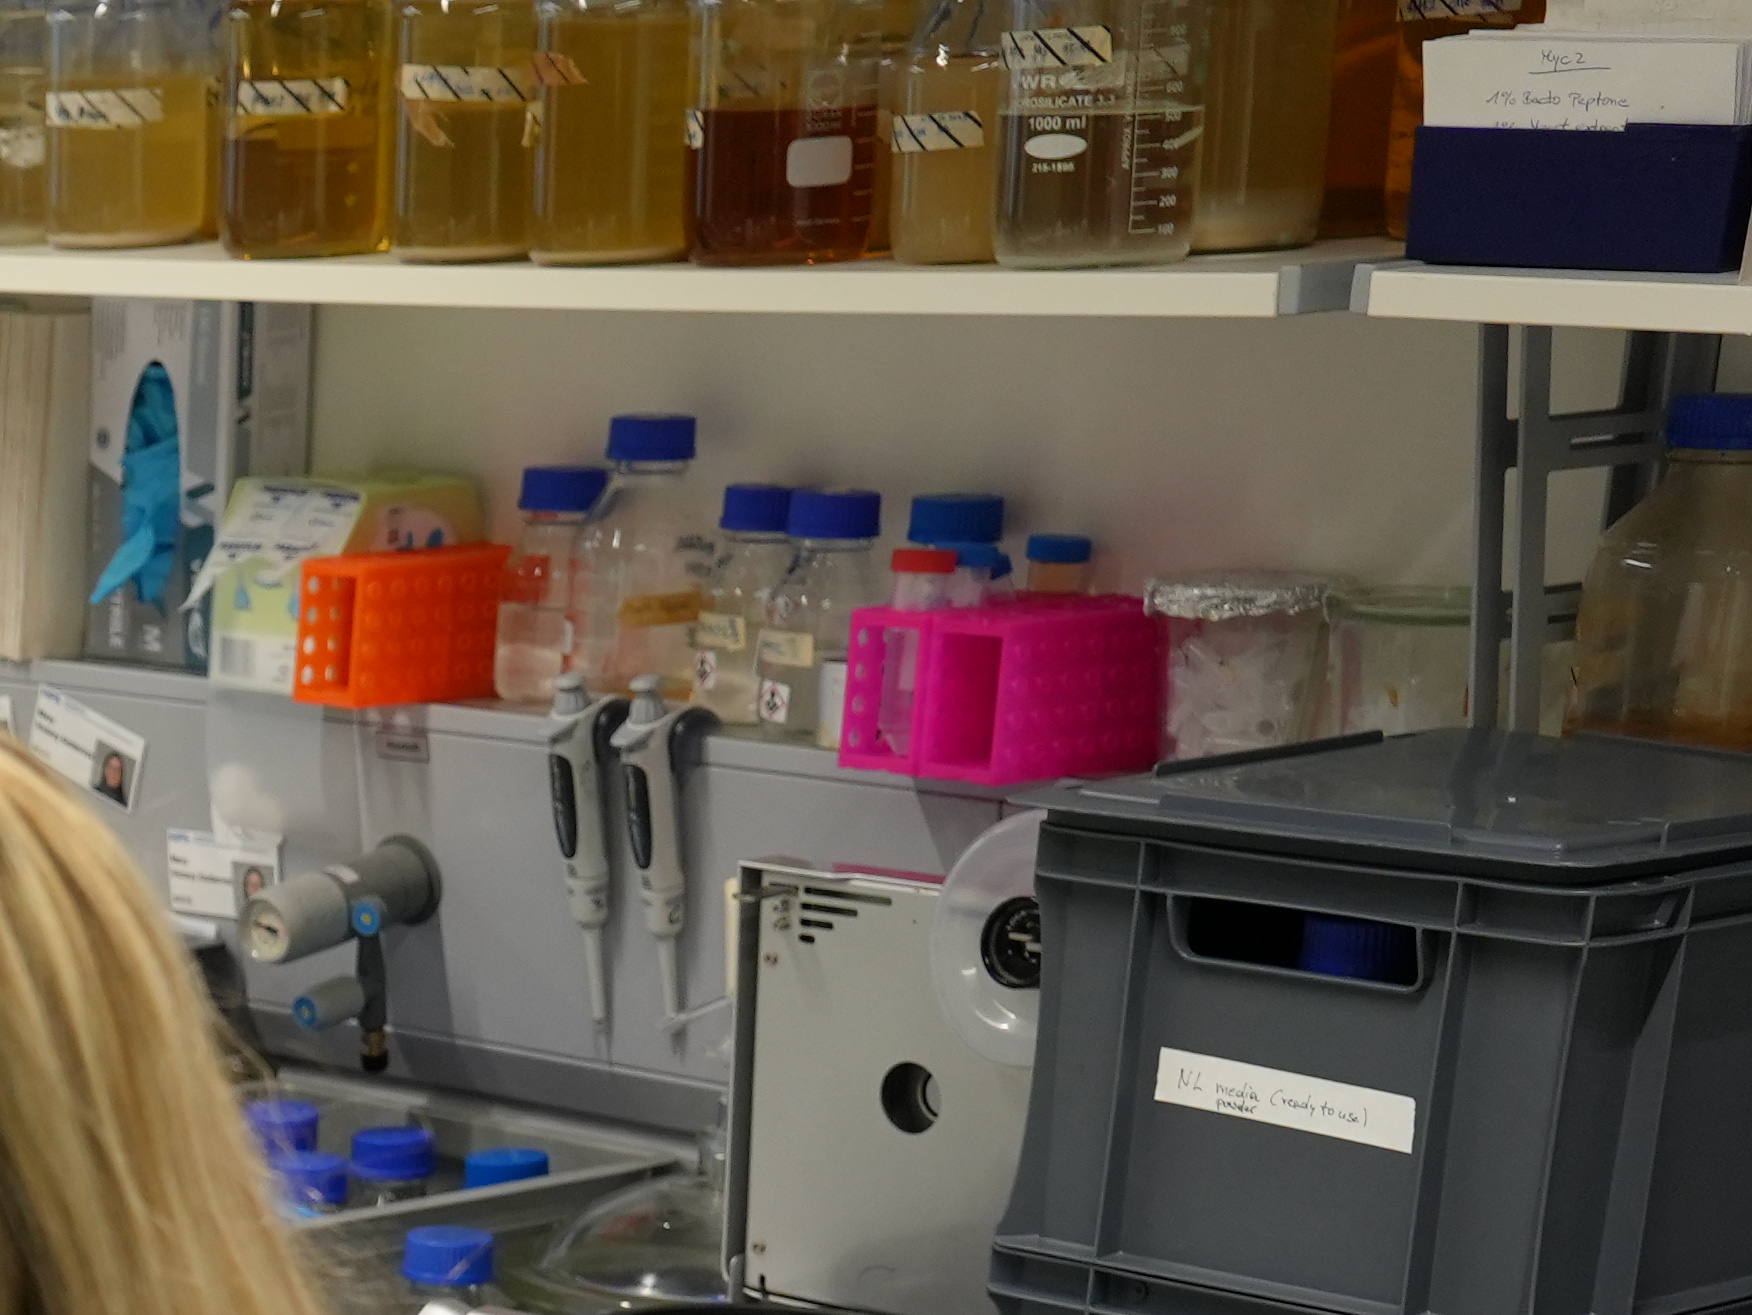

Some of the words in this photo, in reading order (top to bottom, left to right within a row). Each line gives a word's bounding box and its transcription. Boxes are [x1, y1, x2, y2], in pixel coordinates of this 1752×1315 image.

[1021, 74, 1056, 90] WR
[1029, 116, 1062, 131] 1000
[1066, 115, 1087, 131] ml
[1159, 195, 1176, 207] 200
[1157, 222, 1174, 235] 100
[1215, 1082, 1261, 1103] media
